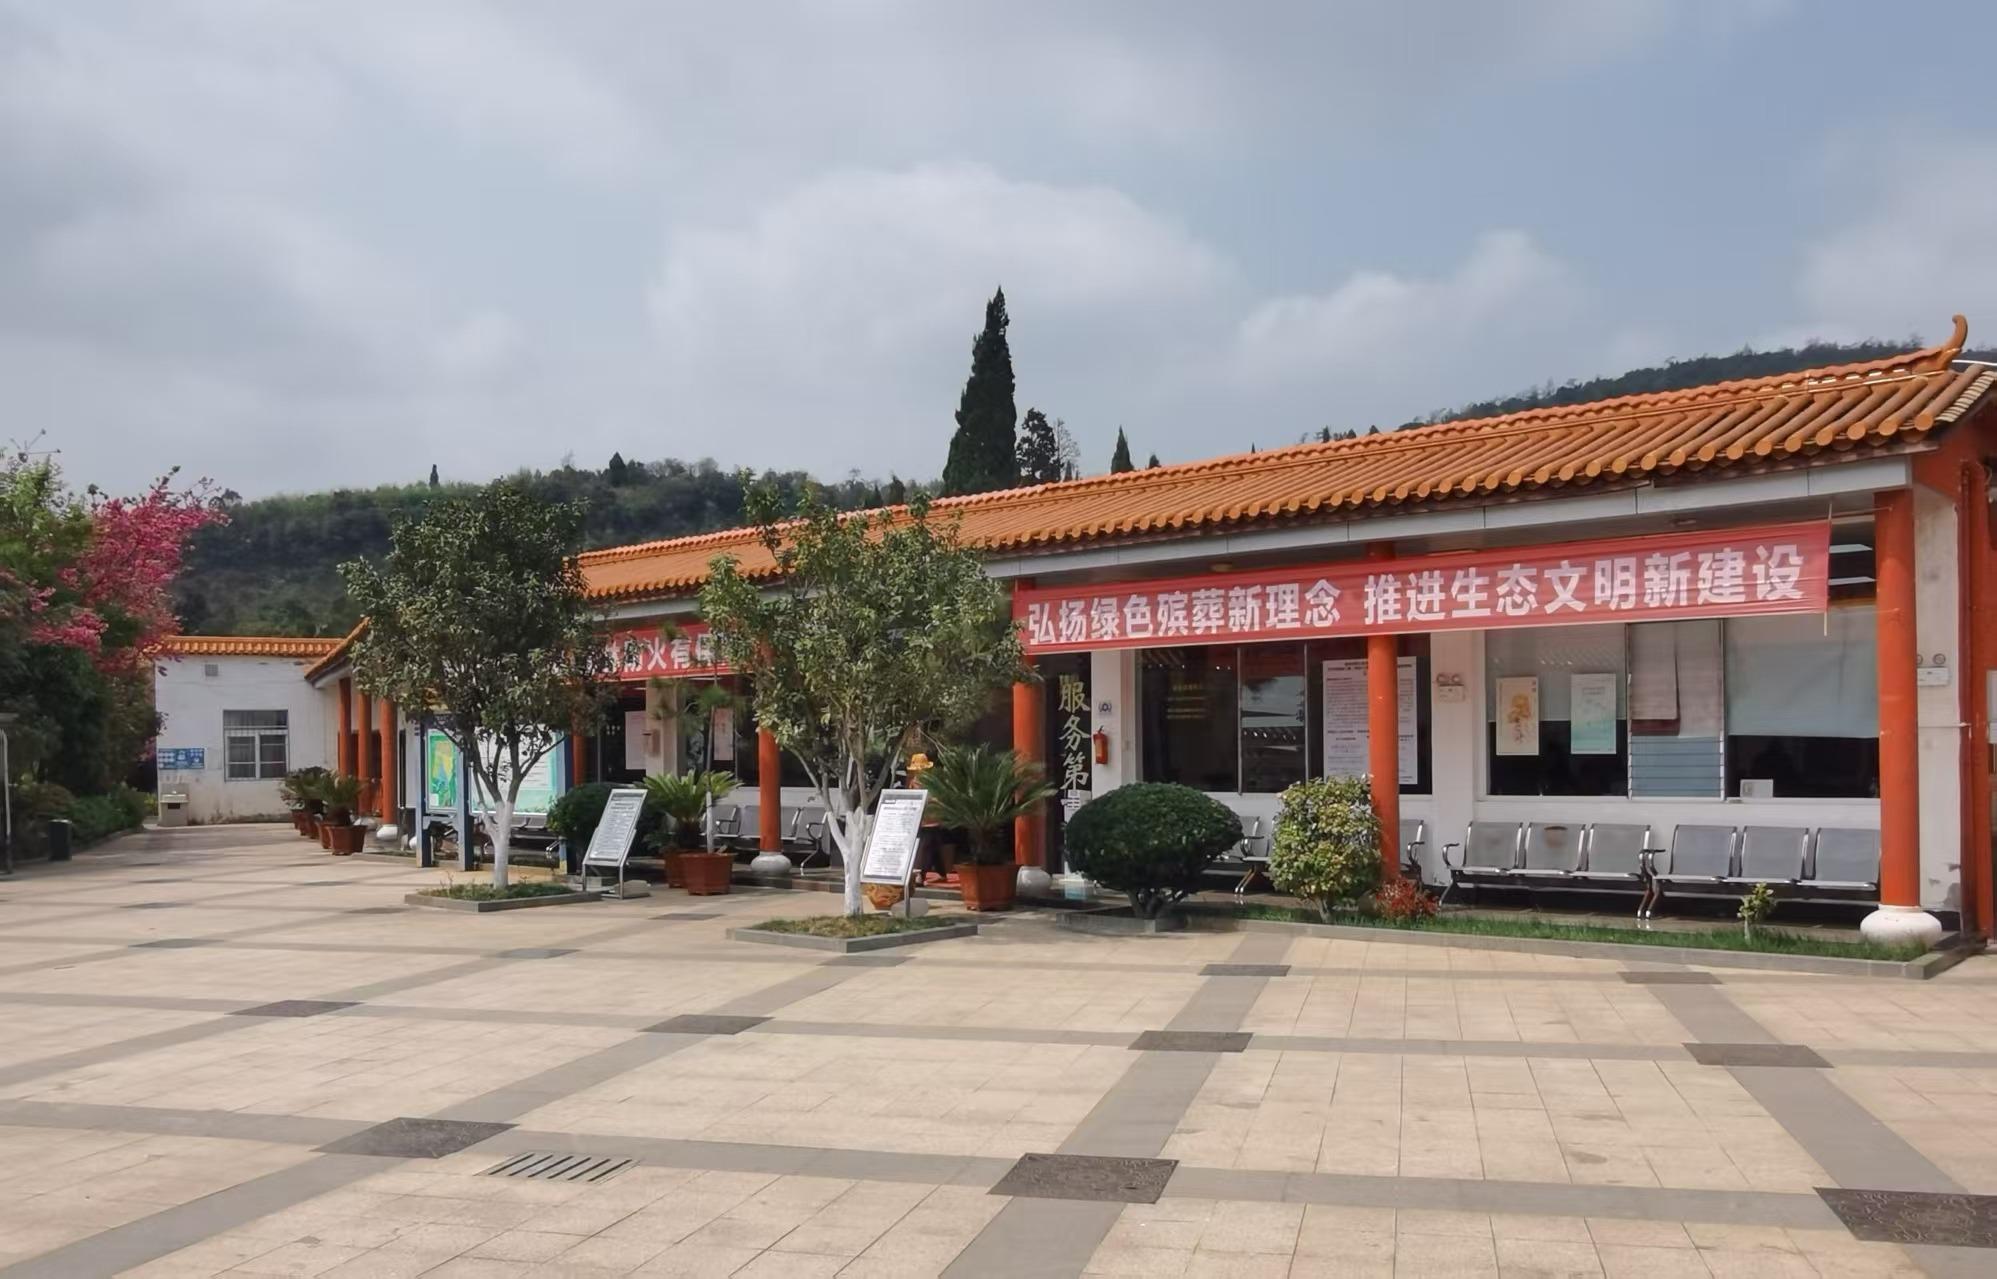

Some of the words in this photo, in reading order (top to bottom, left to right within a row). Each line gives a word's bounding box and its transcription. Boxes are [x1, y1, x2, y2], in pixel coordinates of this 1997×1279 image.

[1028, 579, 1341, 645] 弘扬绿色殡葬新理念
[1364, 545, 1805, 624] 推进生态文明新建设
[1058, 677, 1091, 806] 服务第
